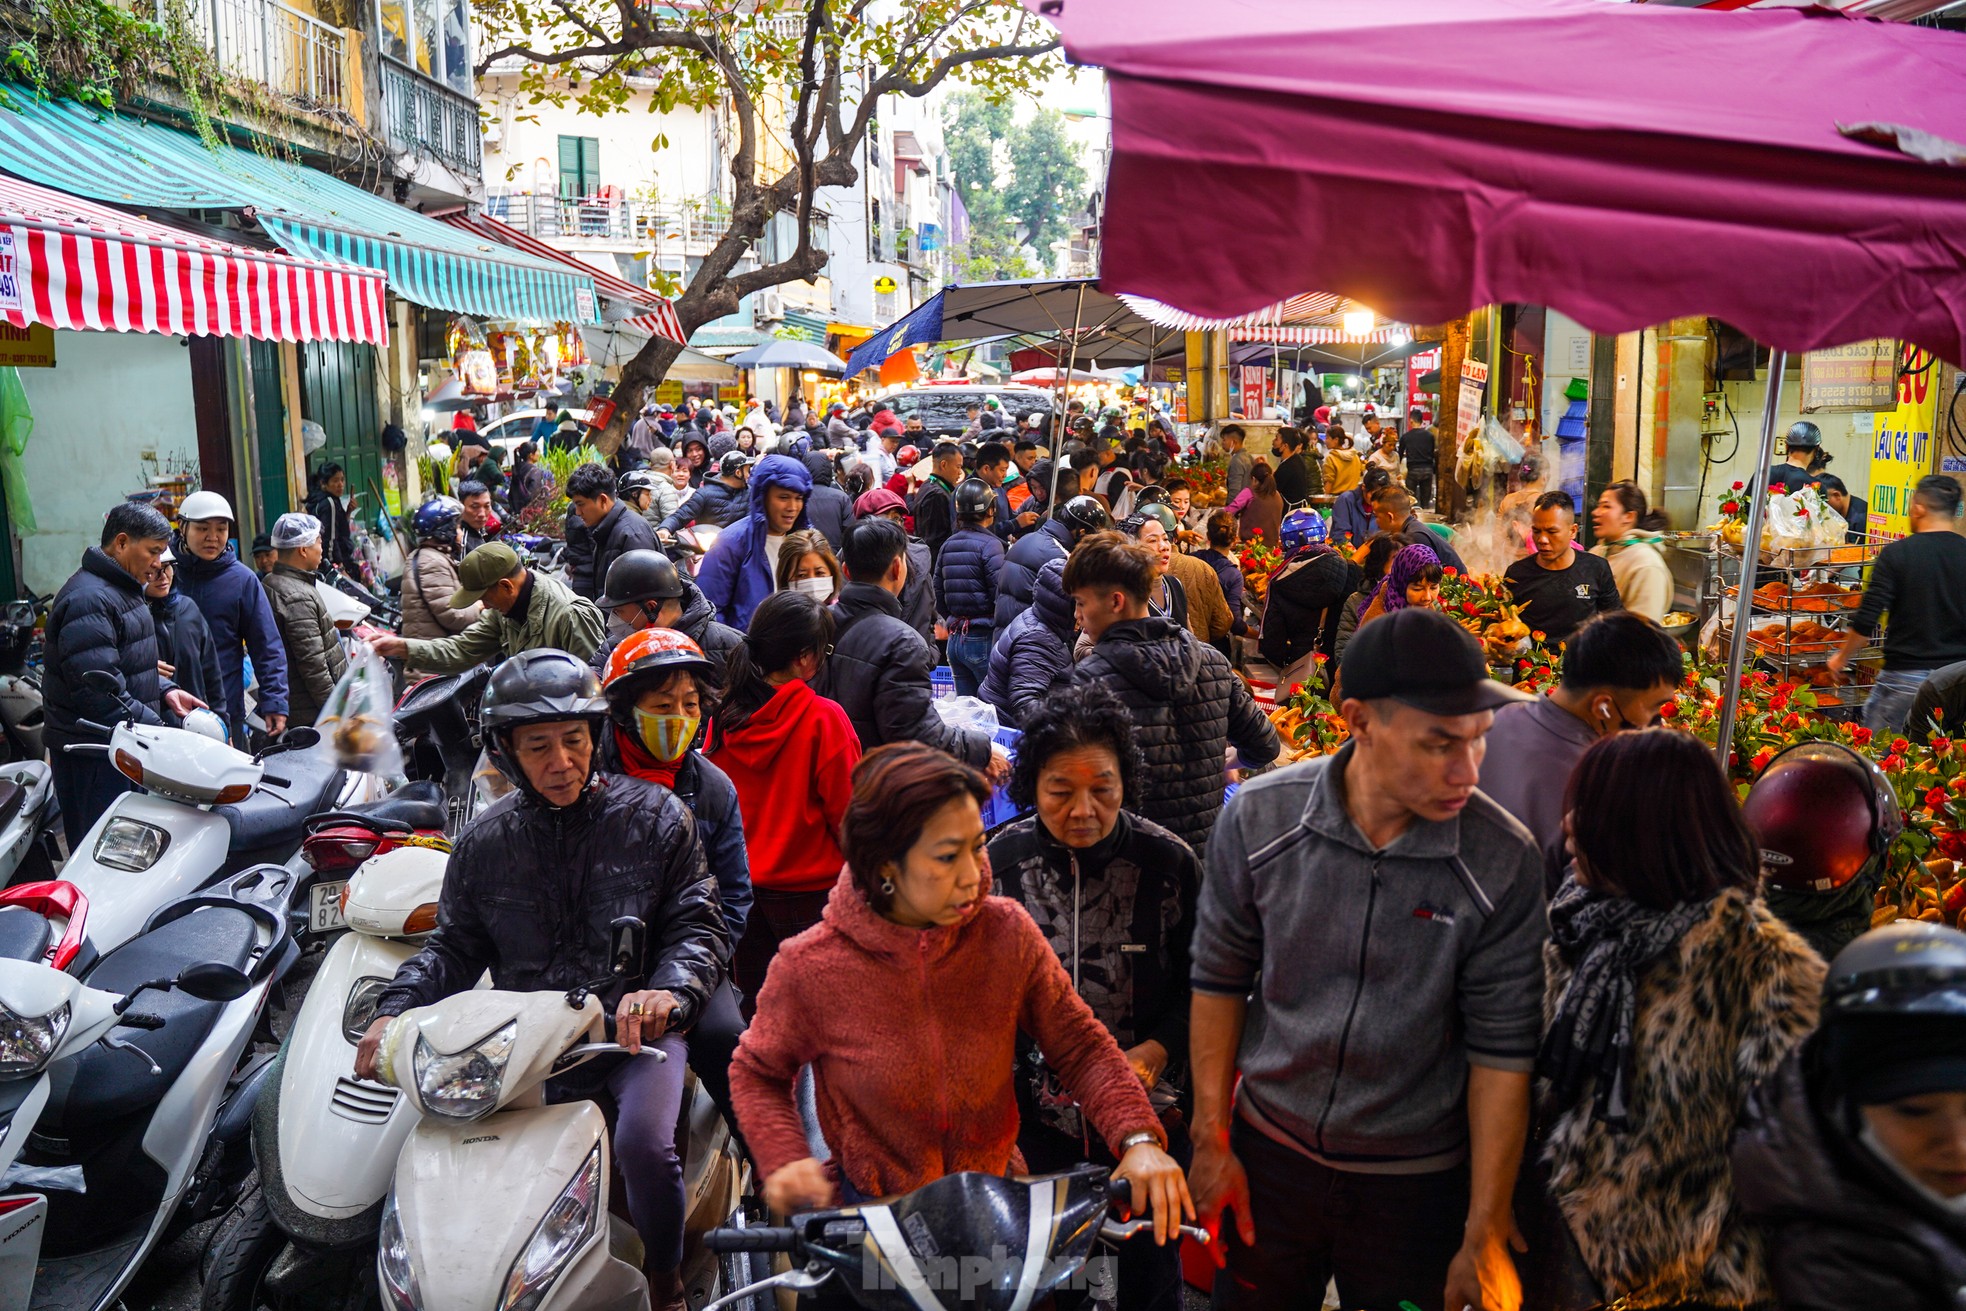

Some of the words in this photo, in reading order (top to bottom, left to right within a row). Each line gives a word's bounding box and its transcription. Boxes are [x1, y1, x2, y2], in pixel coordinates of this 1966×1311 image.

[1411, 355, 1433, 370] SINH
[1245, 366, 1261, 385] SINH
[1874, 416, 1892, 462] LẨU
[1913, 431, 1929, 470] VỊT
[462, 1135, 501, 1145] HONDA
[3, 1214, 41, 1243] HONDA
